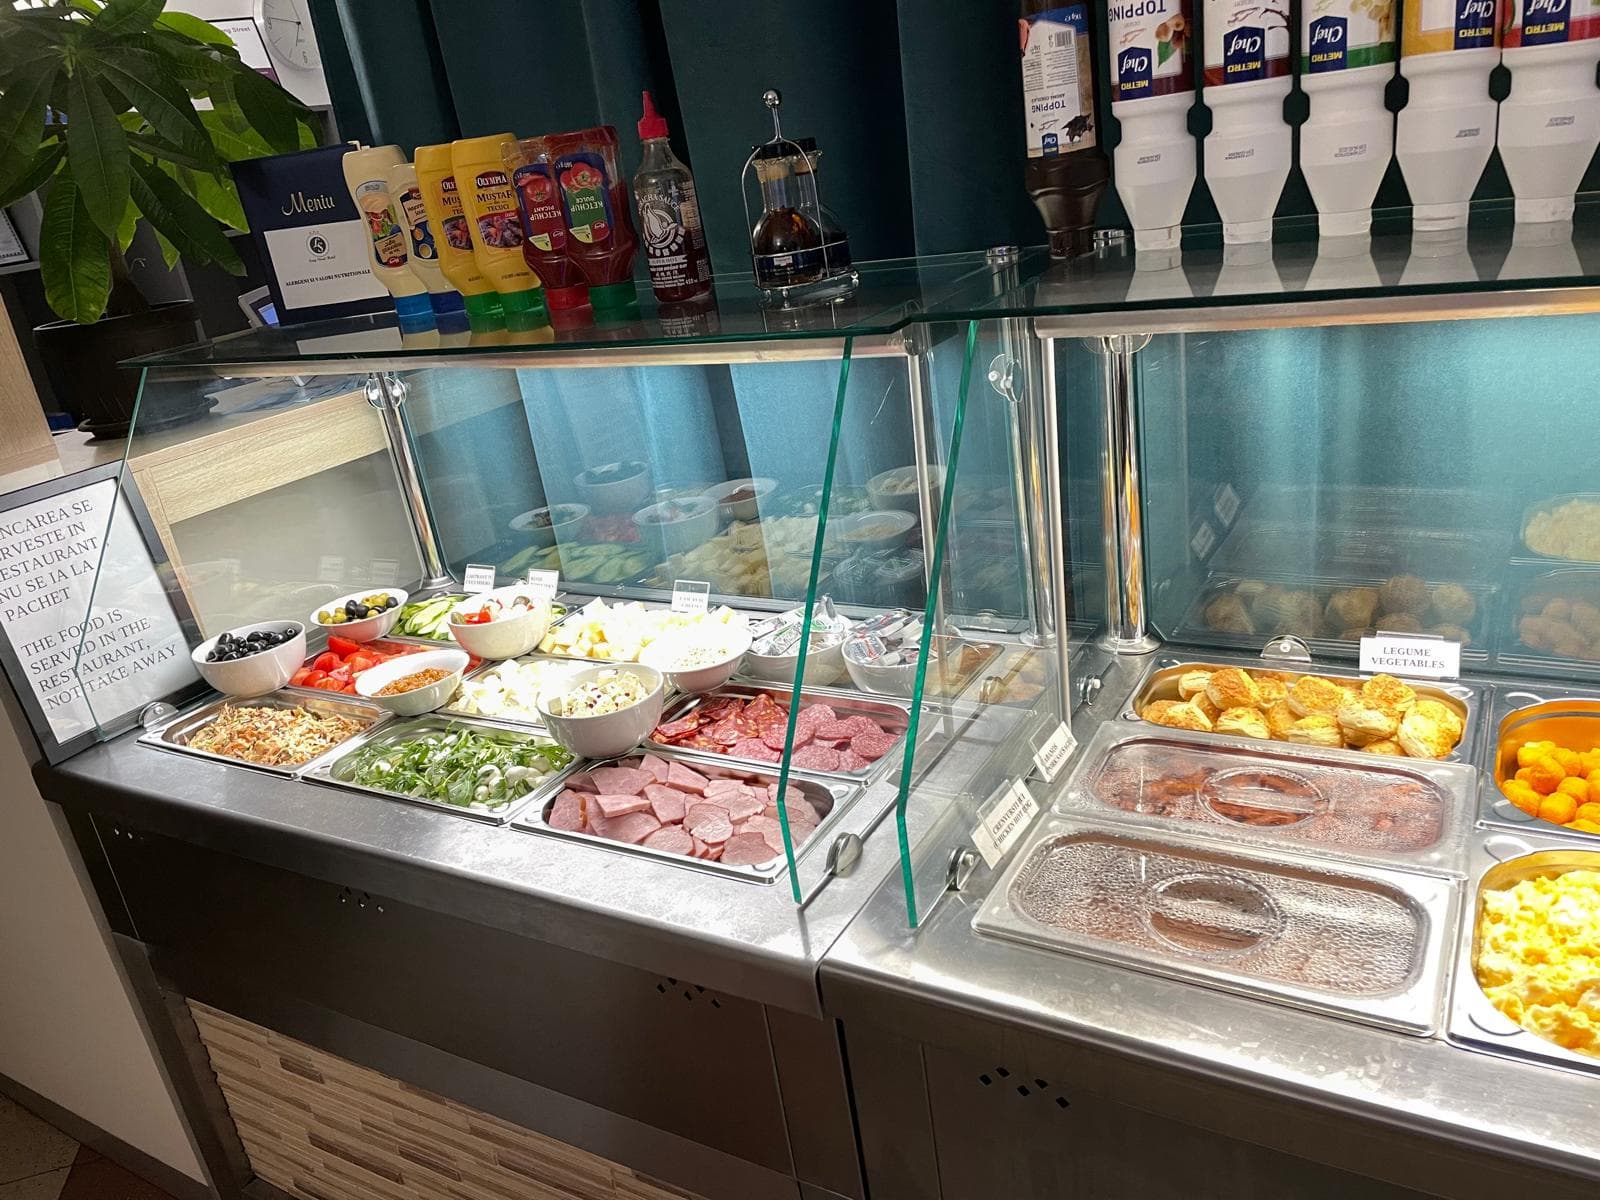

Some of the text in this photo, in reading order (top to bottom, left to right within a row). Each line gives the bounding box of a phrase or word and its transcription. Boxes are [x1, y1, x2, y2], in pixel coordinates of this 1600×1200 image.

[1108, 0, 1167, 22] TOPPING
[1460, 0, 1494, 19] Chef
[1526, 0, 1564, 15] Chef
[1312, 25, 1343, 45] Chef
[1459, 27, 1492, 38] METRO
[1525, 22, 1565, 35] METRO
[1227, 34, 1261, 56] Chef
[1120, 54, 1148, 74] Chef
[1311, 51, 1343, 63] METRO
[1227, 60, 1261, 73] METRO
[1121, 80, 1149, 90] METRO
[1031, 100, 1067, 113] TOPPING
[477, 175, 507, 187] OLYMPIA
[282, 191, 335, 216] Meniu
[476, 190, 513, 203] MUSTAR
[570, 201, 604, 212] KETCHUP
[530, 210, 562, 221] KETCHUP
[71, 499, 93, 516] SE
[67, 521, 86, 537] IN
[0, 560, 94, 605] NU SE IA LA
[5, 587, 71, 622] PACHET
[20, 609, 123, 657] THE FOOD IS
[30, 617, 151, 675] SERVED IN THE
[1383, 646, 1431, 657] LEGUME
[1371, 657, 1445, 669] VEGETABLES
[46, 644, 177, 711] NOT TAKE AWAY
